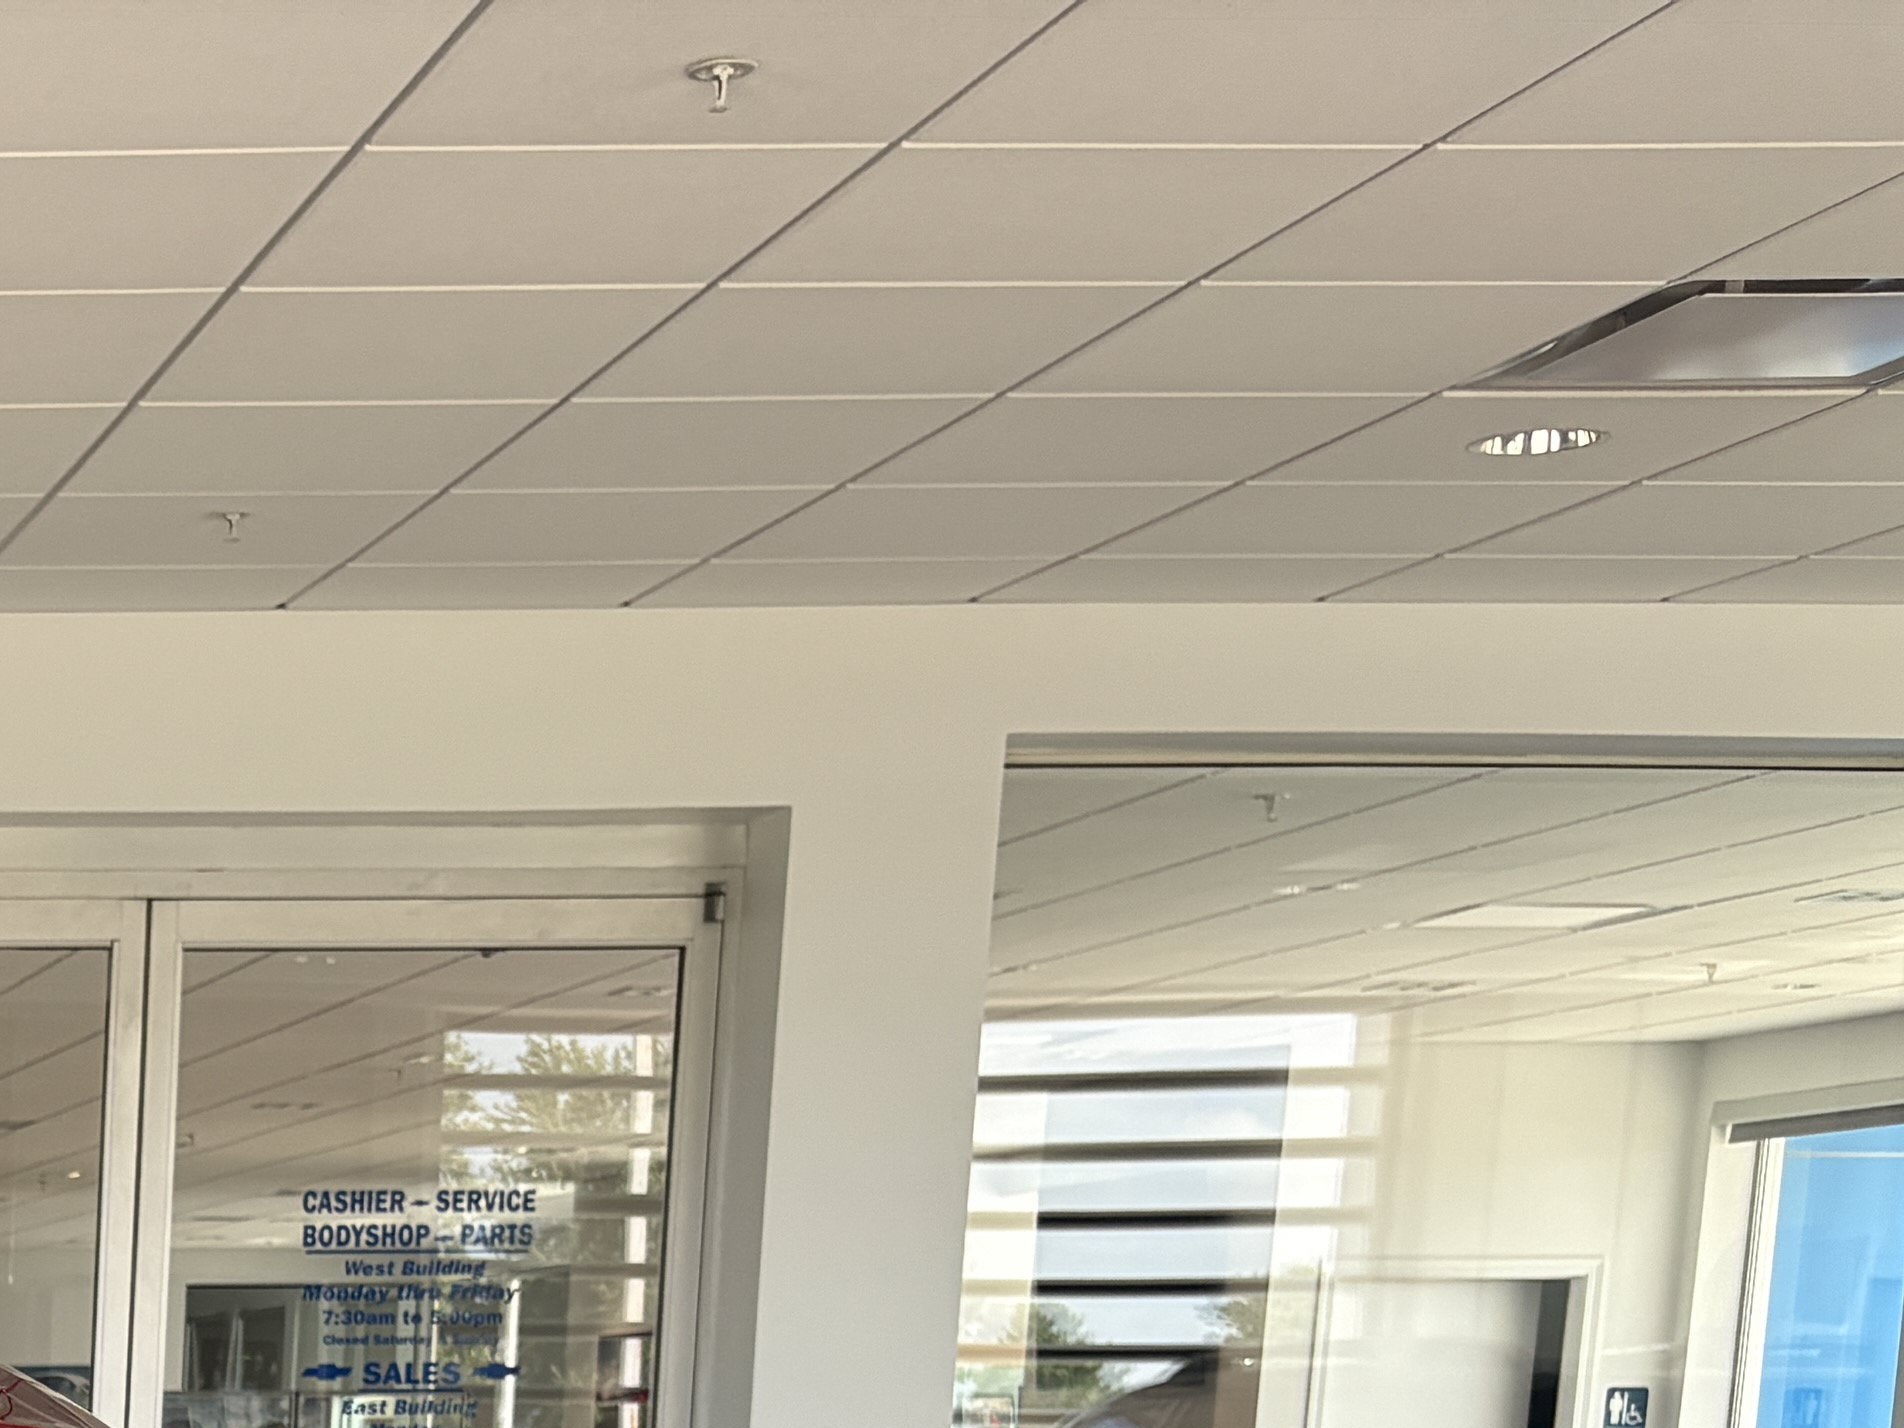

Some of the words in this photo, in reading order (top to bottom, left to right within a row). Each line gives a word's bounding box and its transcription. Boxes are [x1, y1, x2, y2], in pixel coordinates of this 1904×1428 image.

[303, 1190, 406, 1214] CASHIER
[435, 1189, 537, 1213] SERVICE
[302, 1224, 430, 1248] BODYSHOP
[460, 1223, 534, 1247] PARTS
[344, 1260, 395, 1277] West
[401, 1259, 487, 1279] Building
[302, 1284, 390, 1306] Monday
[397, 1284, 441, 1303] thru
[450, 1283, 522, 1305] Friday
[322, 1310, 397, 1326] 7:30am
[402, 1309, 423, 1326] to
[322, 1334, 370, 1347] Closed
[362, 1362, 462, 1386] SALES
[342, 1399, 387, 1416] East
[393, 1399, 478, 1419] Building
